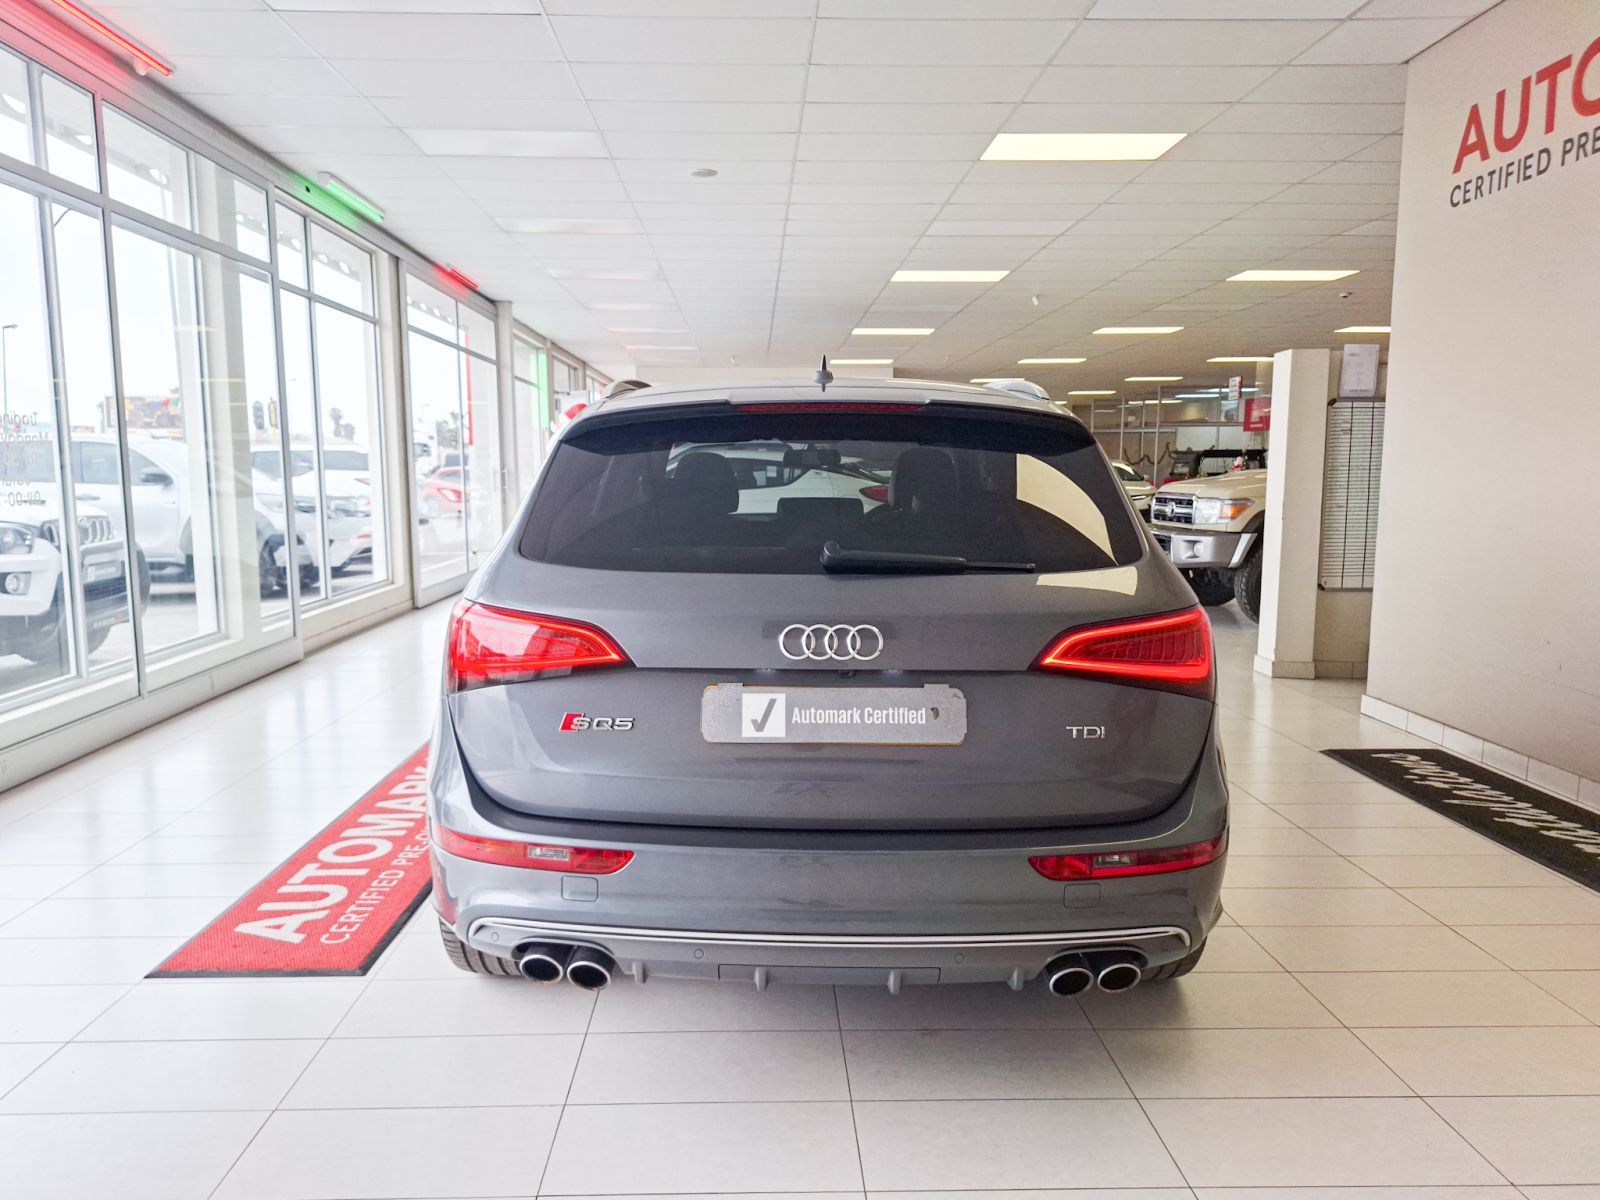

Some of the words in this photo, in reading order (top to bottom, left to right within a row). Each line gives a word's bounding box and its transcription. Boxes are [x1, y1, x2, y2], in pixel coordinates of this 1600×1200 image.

[1452, 36, 1600, 174] AUTO
[1450, 147, 1550, 207] CERTIFIED
[563, 714, 634, 732] SQ5
[1066, 726, 1105, 739] TDI
[320, 868, 405, 945] CERTIFIED
